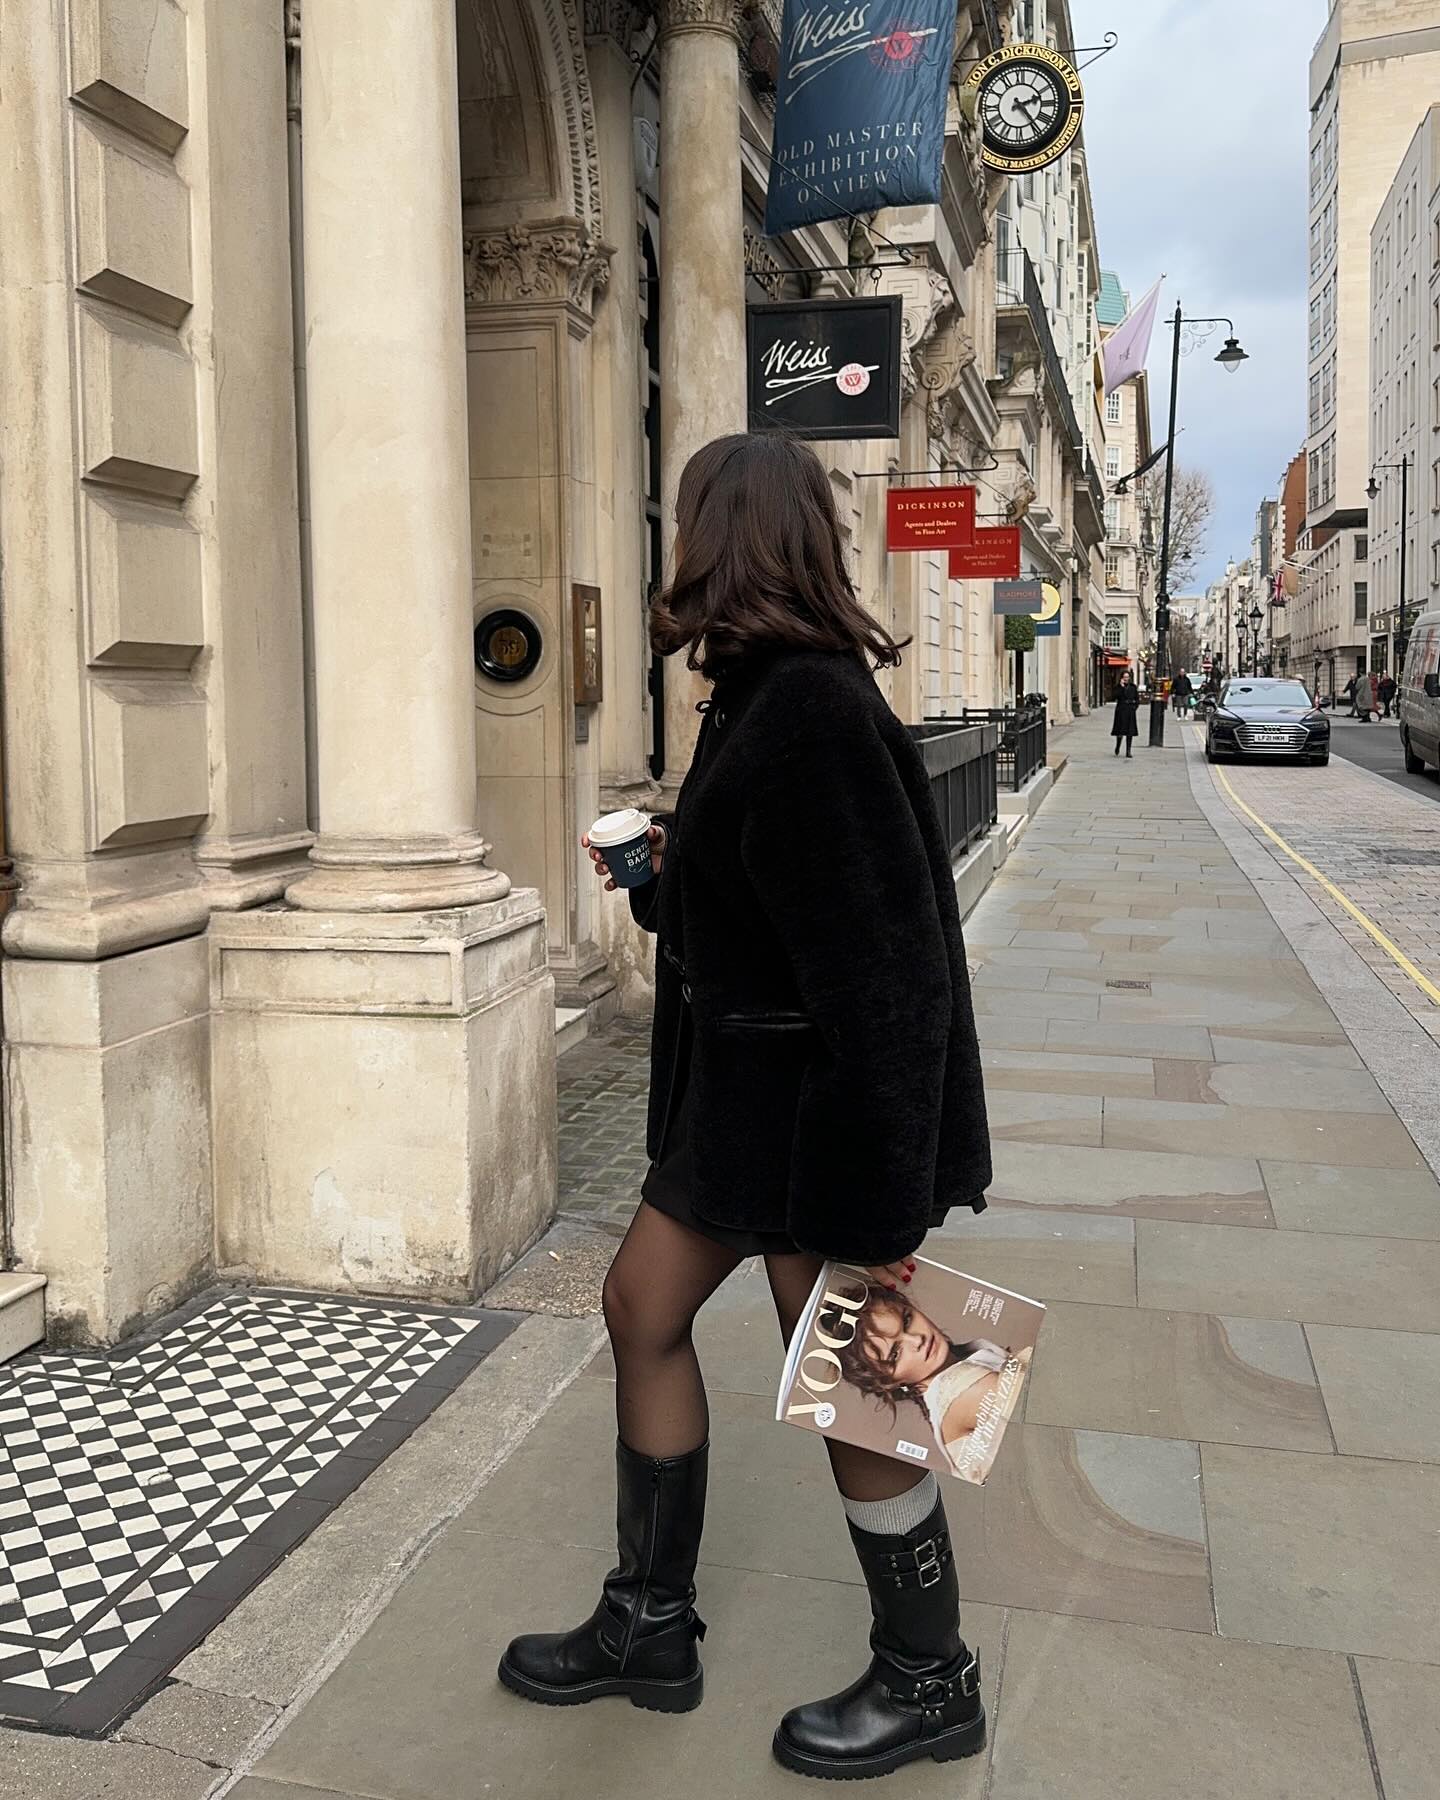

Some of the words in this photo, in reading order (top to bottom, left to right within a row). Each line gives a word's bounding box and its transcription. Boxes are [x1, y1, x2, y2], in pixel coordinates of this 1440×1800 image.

[789, 0, 871, 61] Weiss
[967, 65, 988, 88] MON
[1001, 46, 1066, 69] DICKINSON
[1062, 68, 1079, 92] LTD
[778, 140, 814, 163] OLD
[827, 122, 923, 150] MASTER
[983, 151, 1011, 168] DERN
[1010, 152, 1048, 168] MASTER
[1047, 112, 1080, 155] PAINTINGS
[779, 144, 917, 187] EXHIBITION
[798, 184, 826, 203] ON
[833, 169, 890, 195] VIEW
[760, 339, 831, 376] Weiss
[897, 501, 965, 511] DICKINSON
[904, 521, 924, 529] Agents
[1375, 619, 1385, 631] B
[783, 1264, 870, 1421] VOGU
